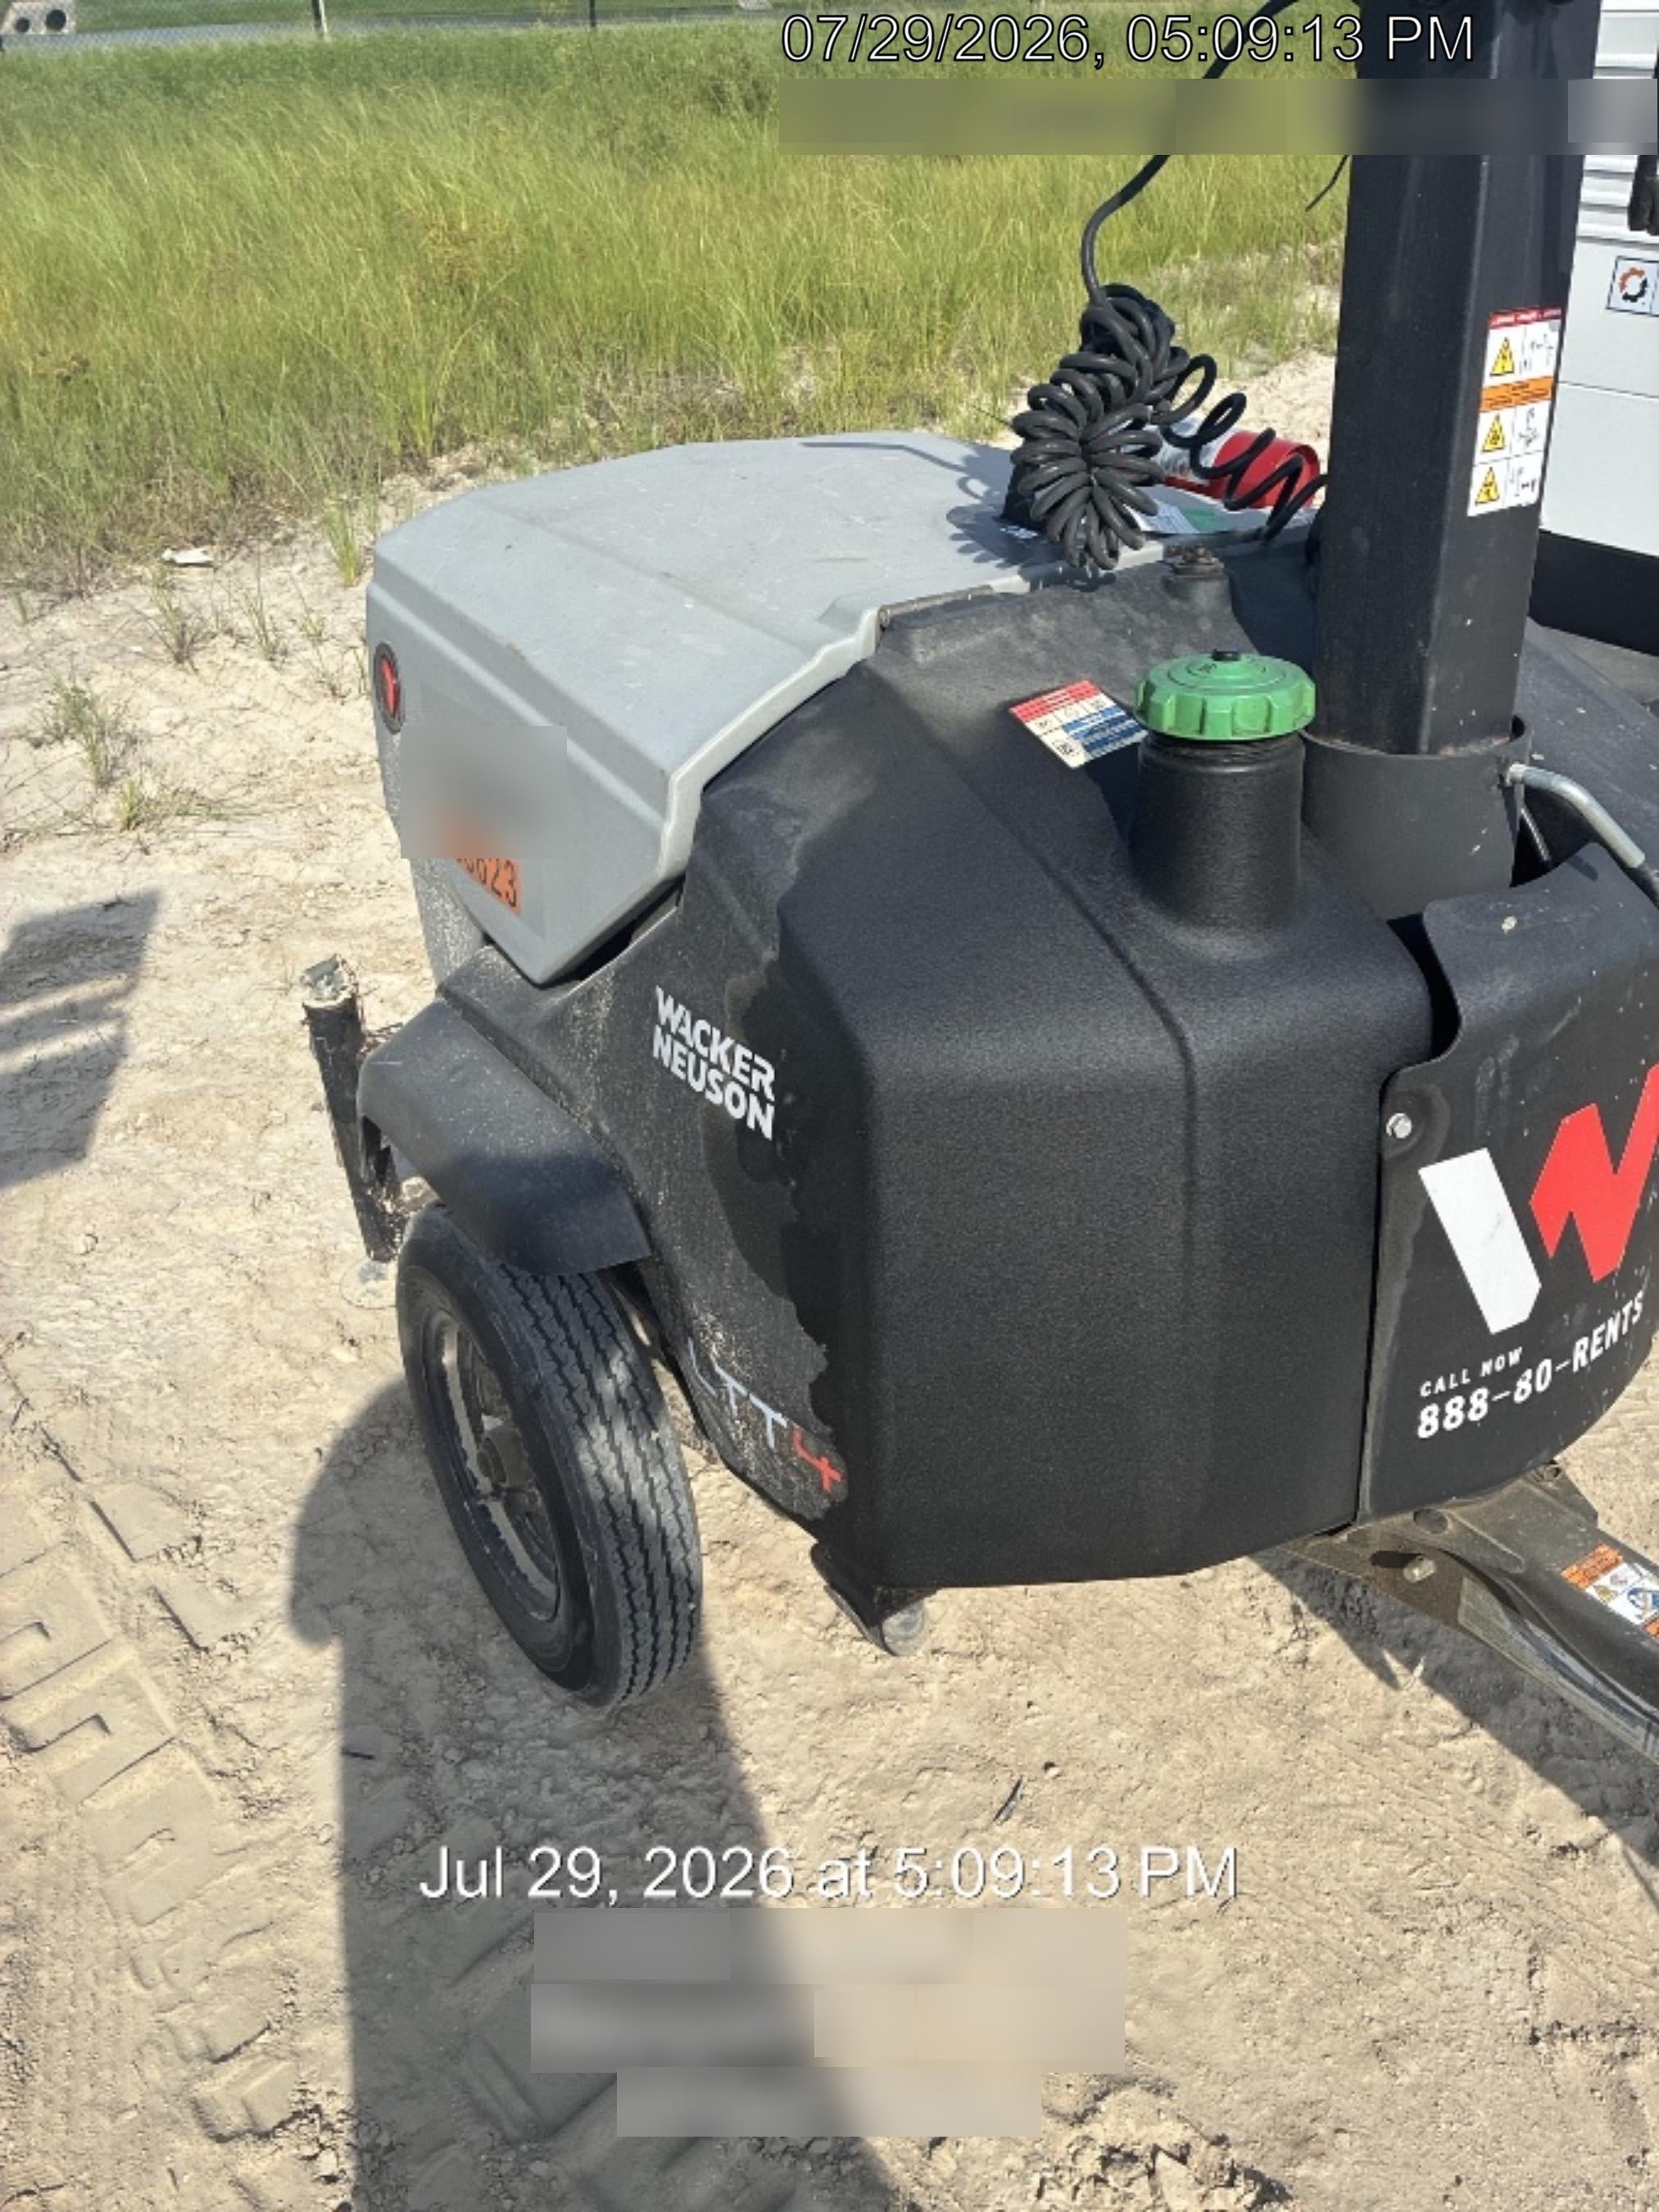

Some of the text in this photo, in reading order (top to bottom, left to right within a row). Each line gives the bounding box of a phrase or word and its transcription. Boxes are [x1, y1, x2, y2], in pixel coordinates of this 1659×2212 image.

[653, 1024, 775, 1141] NEUSON
[655, 985, 775, 1102] WACKER
[1417, 1290, 1643, 1439] 888-80-RENTS
[1420, 1346, 1522, 1397] CALL NOW
